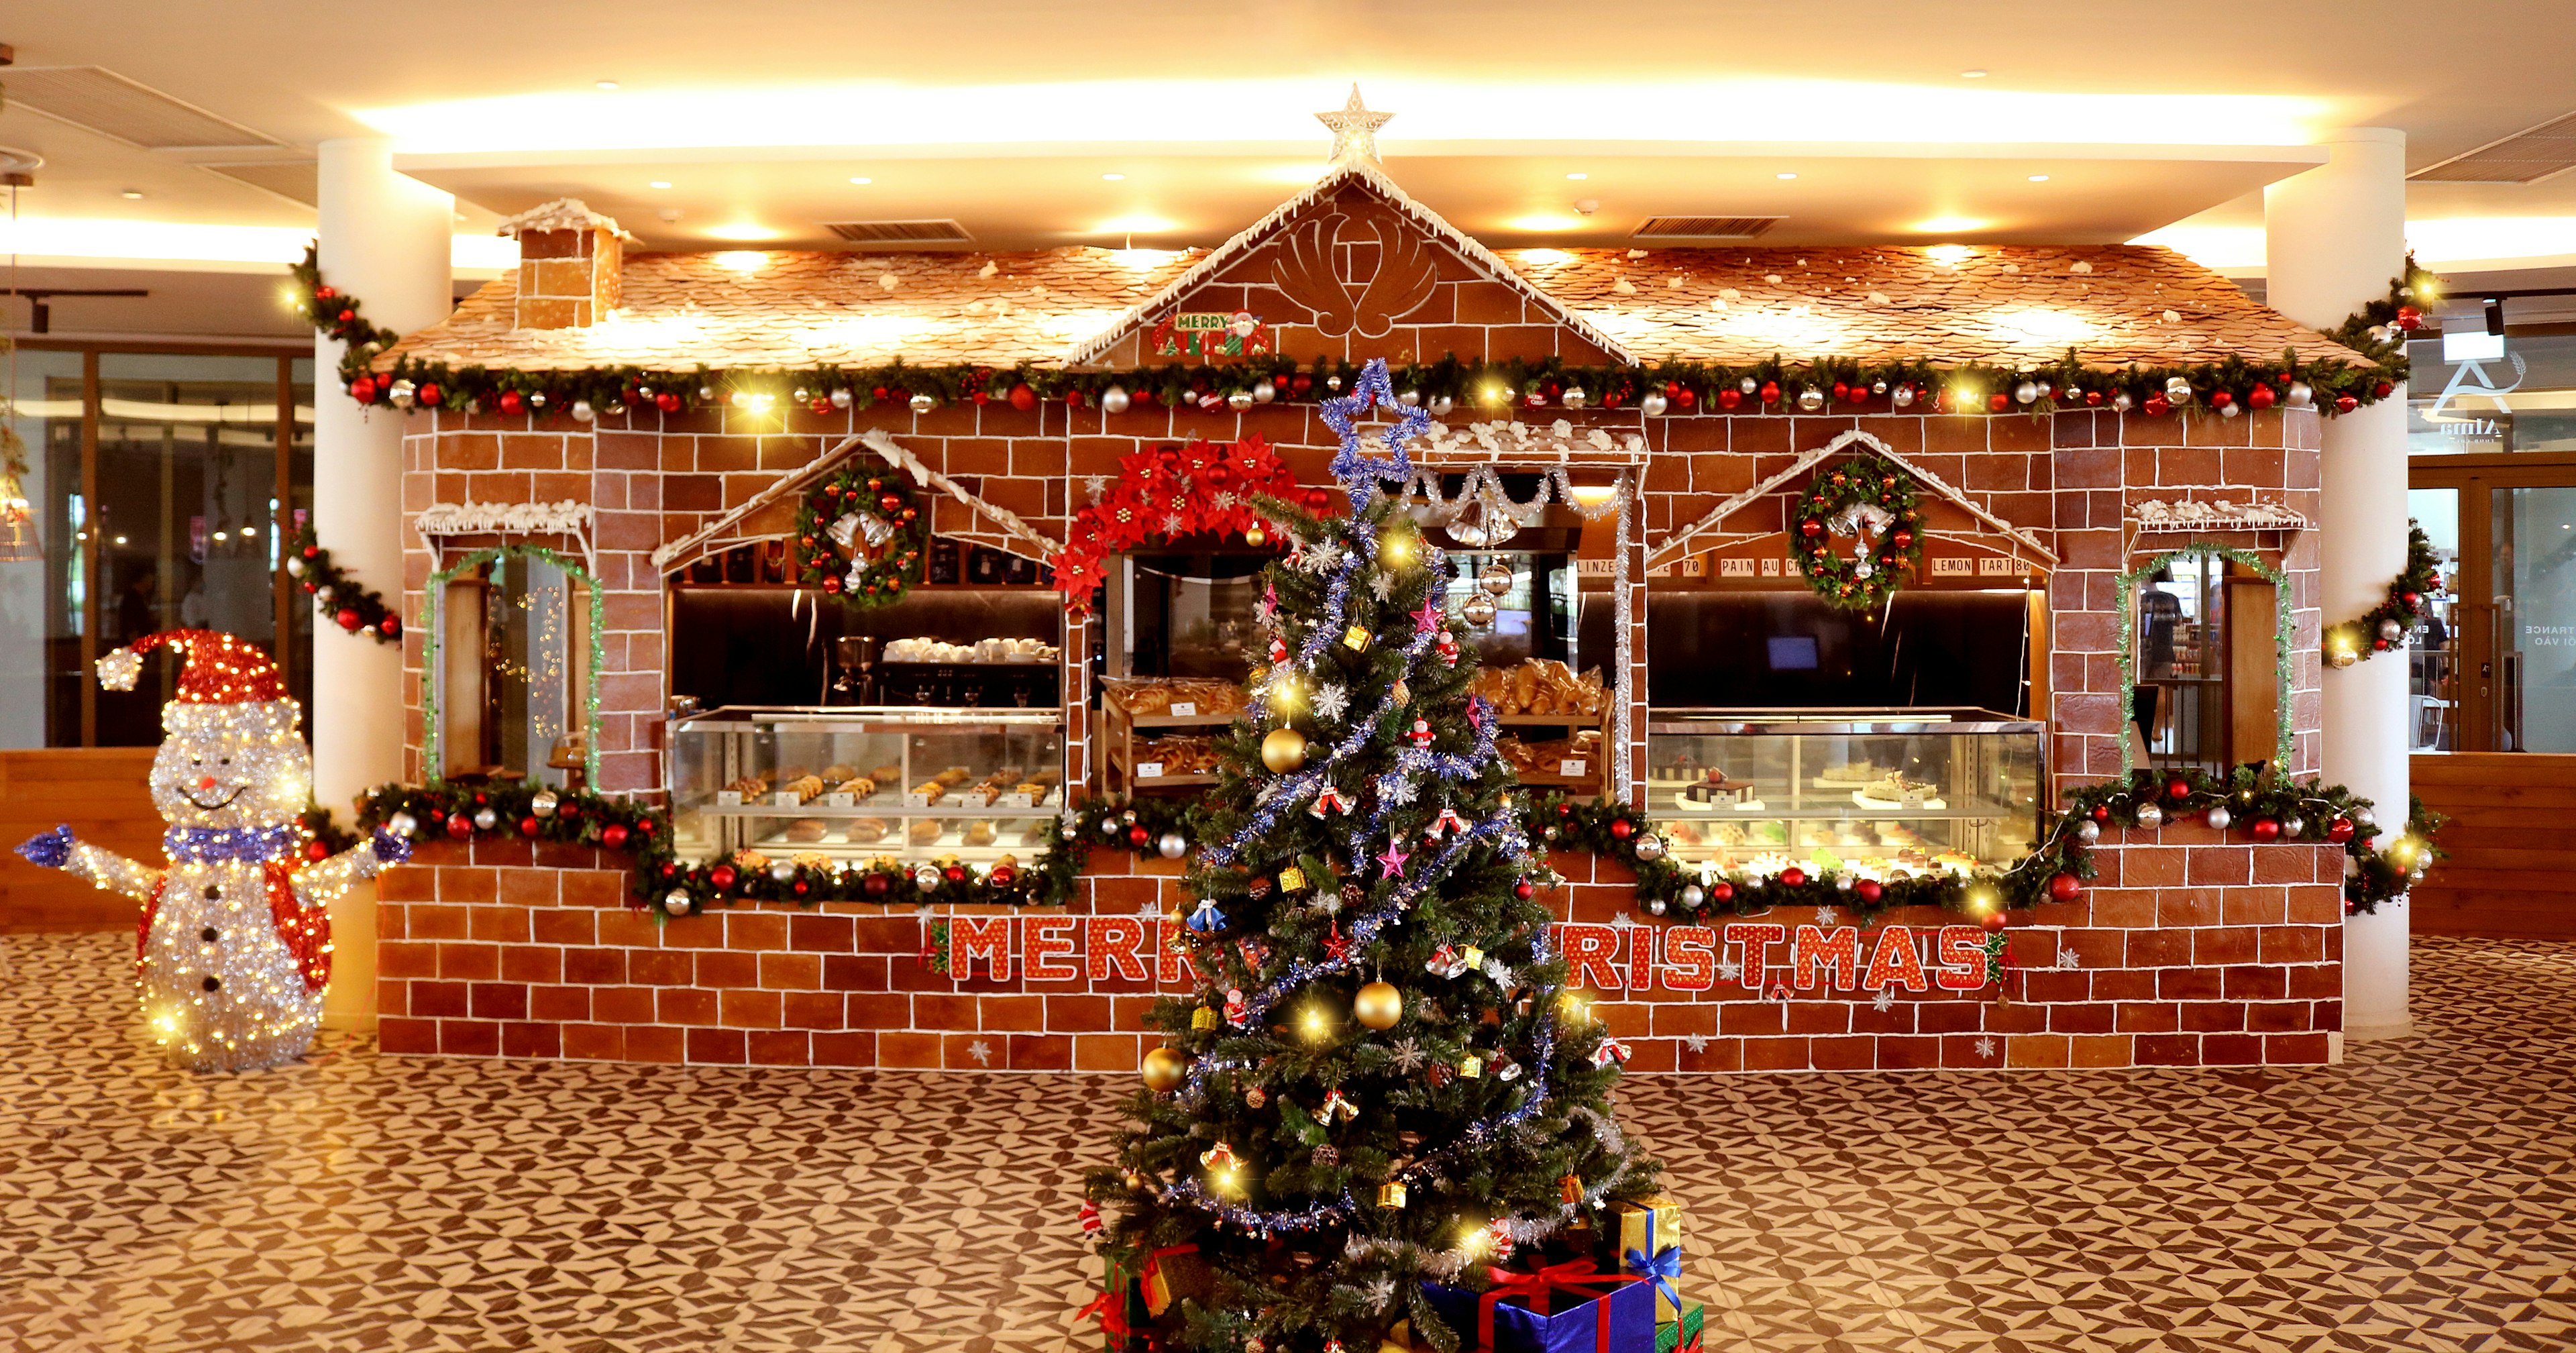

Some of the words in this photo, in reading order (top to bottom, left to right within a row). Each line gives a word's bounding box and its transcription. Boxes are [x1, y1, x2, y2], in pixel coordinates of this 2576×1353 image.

[1177, 313, 1230, 328] MERRY
[1577, 561, 1614, 572] LINZE
[1684, 561, 1699, 572] 70
[1723, 560, 1752, 572] PAIN
[1764, 560, 1778, 572] AU
[1933, 559, 1971, 571] LEMON
[1981, 559, 2010, 571] TART
[949, 916, 1205, 983] MERR
[1560, 922, 1989, 991] RISTMAS
